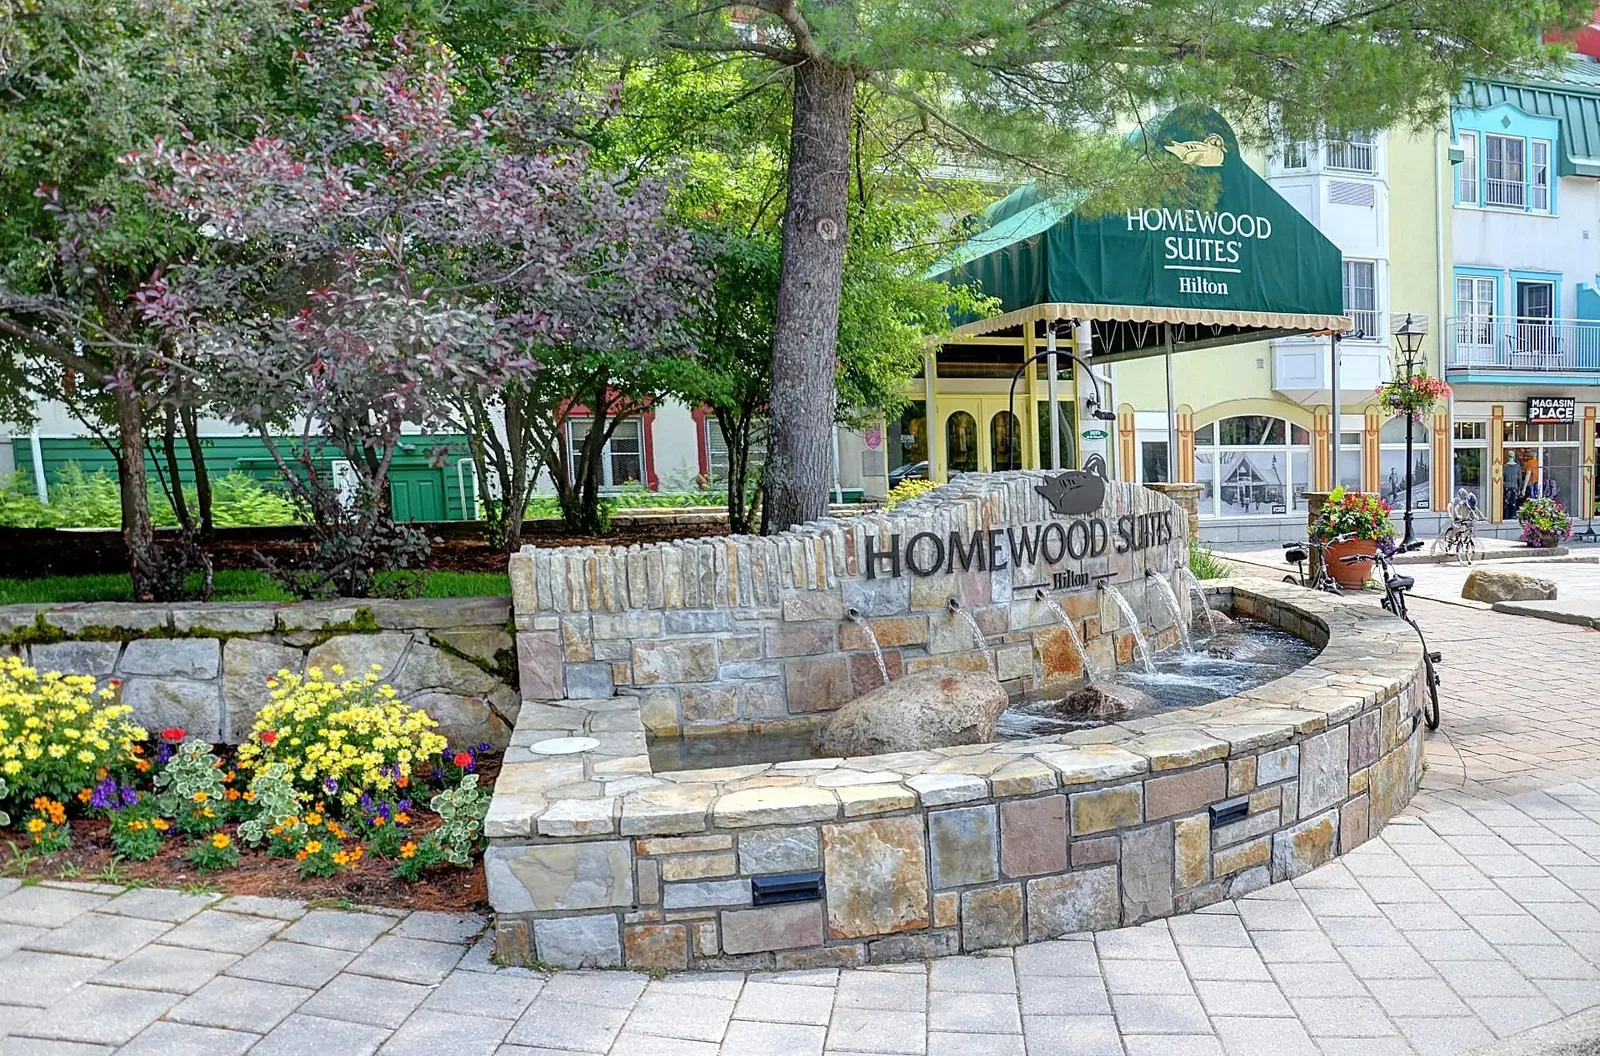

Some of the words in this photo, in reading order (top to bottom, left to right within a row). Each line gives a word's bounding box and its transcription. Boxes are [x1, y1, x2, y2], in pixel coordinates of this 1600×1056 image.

[1127, 207, 1272, 239] HOMEWOOD
[1165, 236, 1241, 263] SUITES
[1179, 276, 1228, 295] Hilton
[1531, 408, 1573, 418] PLACE
[1532, 399, 1573, 407] MAGASIN
[865, 518, 1108, 579] HOMEWOOD
[1117, 510, 1173, 554] SUITES
[1053, 571, 1089, 591] Hilton
